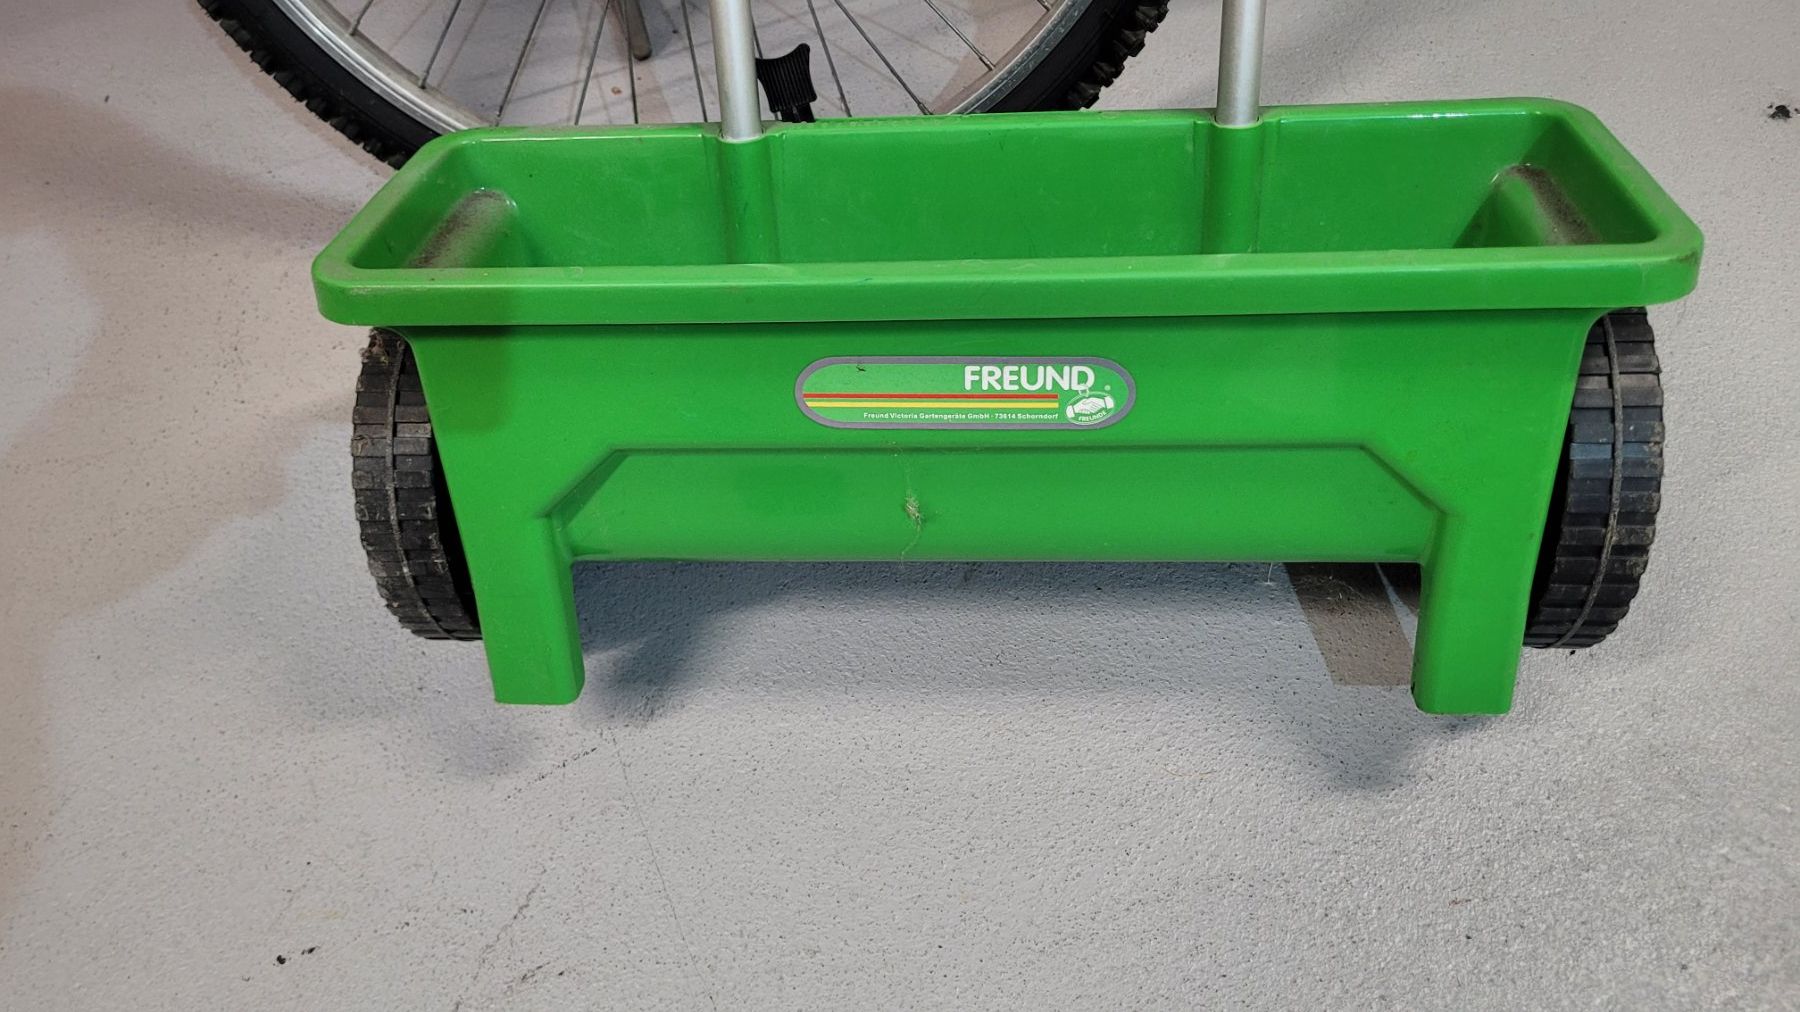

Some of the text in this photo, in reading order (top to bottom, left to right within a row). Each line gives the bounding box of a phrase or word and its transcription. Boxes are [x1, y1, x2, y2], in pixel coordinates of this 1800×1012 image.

[964, 365, 1095, 391] FREUND
[889, 412, 918, 420] Victoria
[919, 412, 966, 421] Gartengeräte
[967, 412, 990, 420] GmbH
